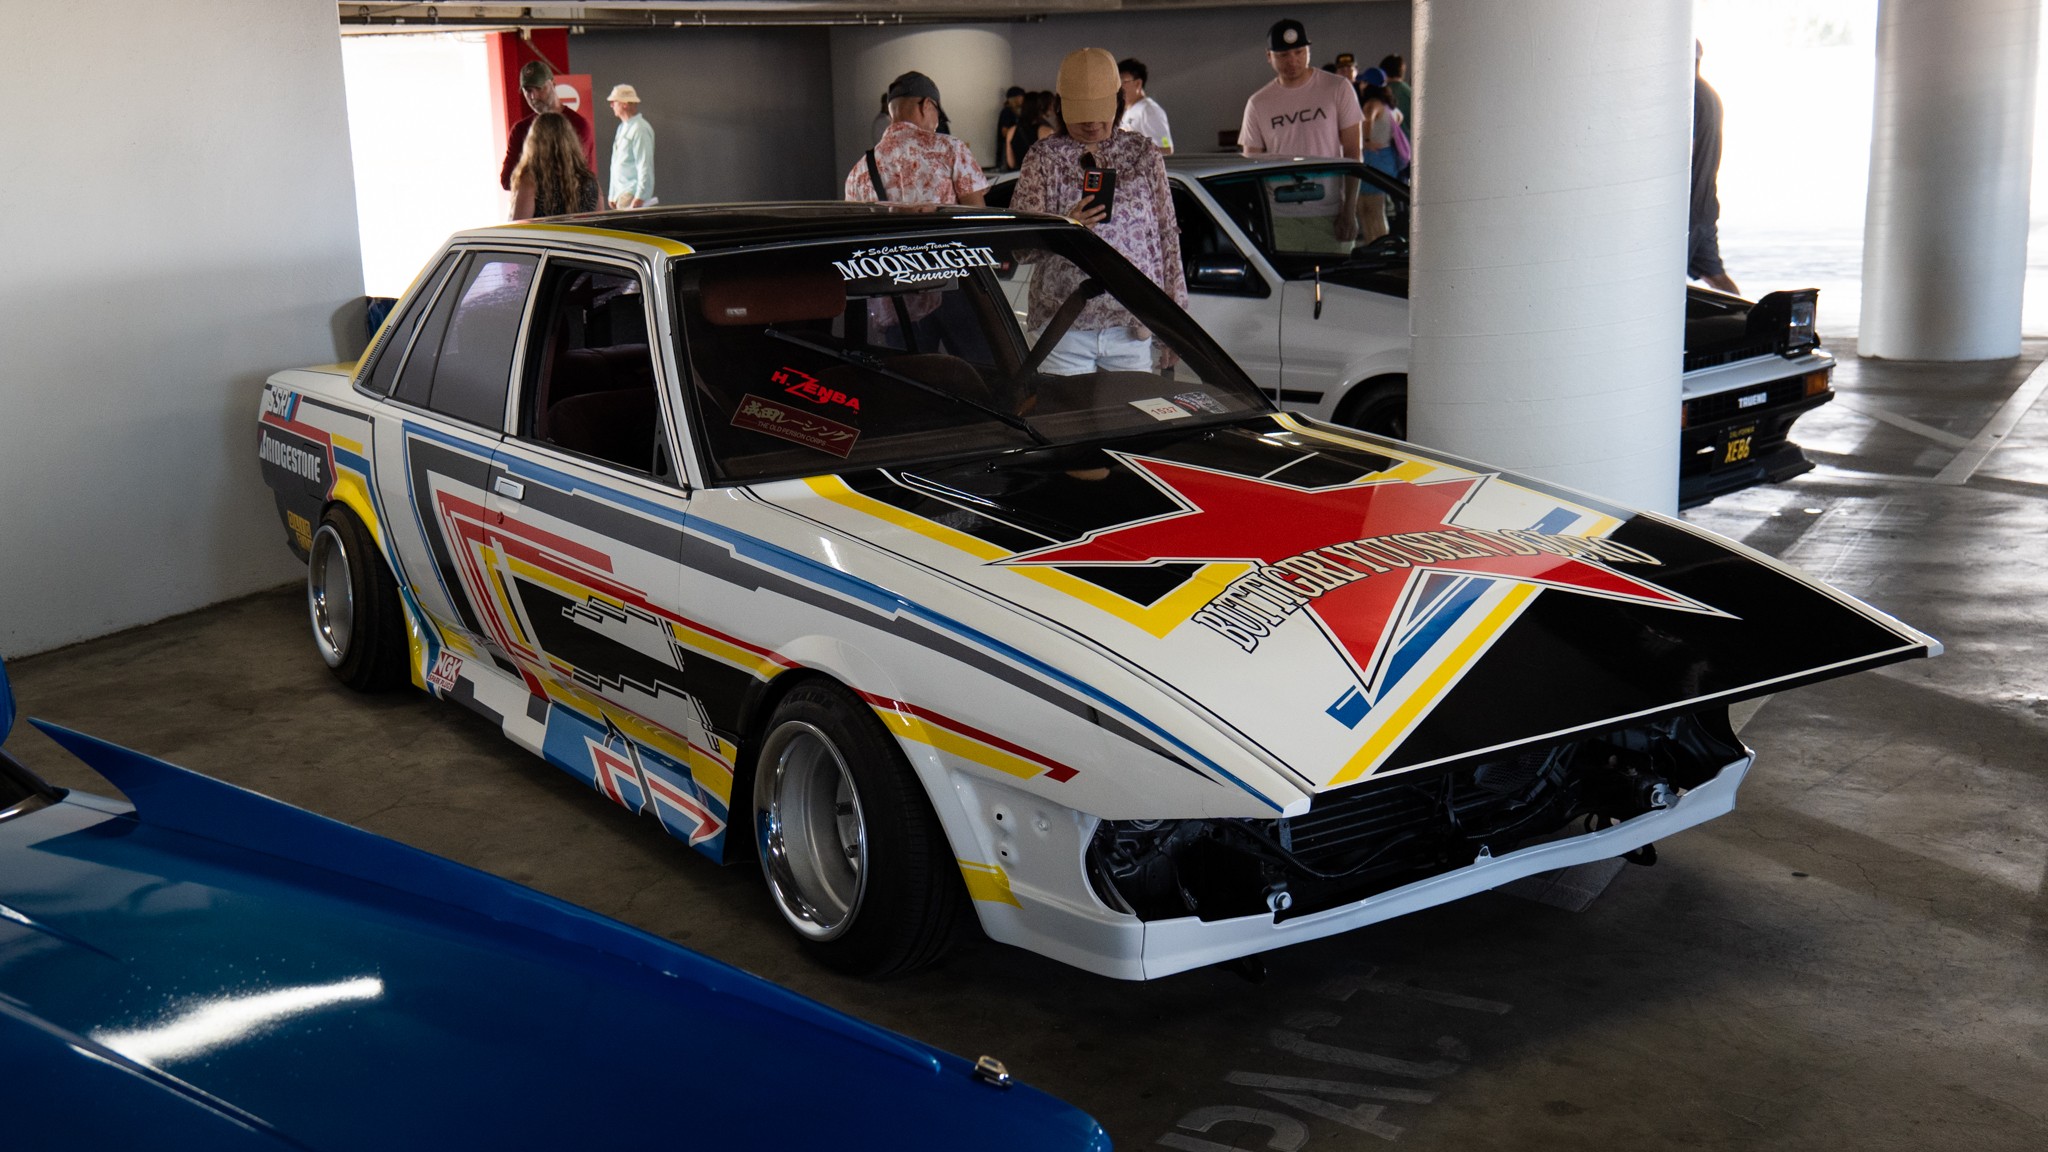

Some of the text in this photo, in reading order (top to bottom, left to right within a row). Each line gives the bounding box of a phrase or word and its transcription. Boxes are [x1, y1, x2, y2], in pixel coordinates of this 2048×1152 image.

[1271, 108, 1327, 129] RVCA
[926, 242, 950, 250] Team
[832, 247, 1000, 281] MOONLIGHT
[889, 268, 970, 285] Runners
[1738, 392, 1767, 409] TRUENO
[757, 420, 827, 448] THE OLD PERSON CORPS
[259, 430, 321, 483] BRIDGESTONE
[1191, 550, 1371, 654] BUTTIGIRI
[1319, 529, 1508, 573] YUUSEN
[433, 652, 462, 682] NGK
[429, 674, 454, 690] SPARK PLUGS
